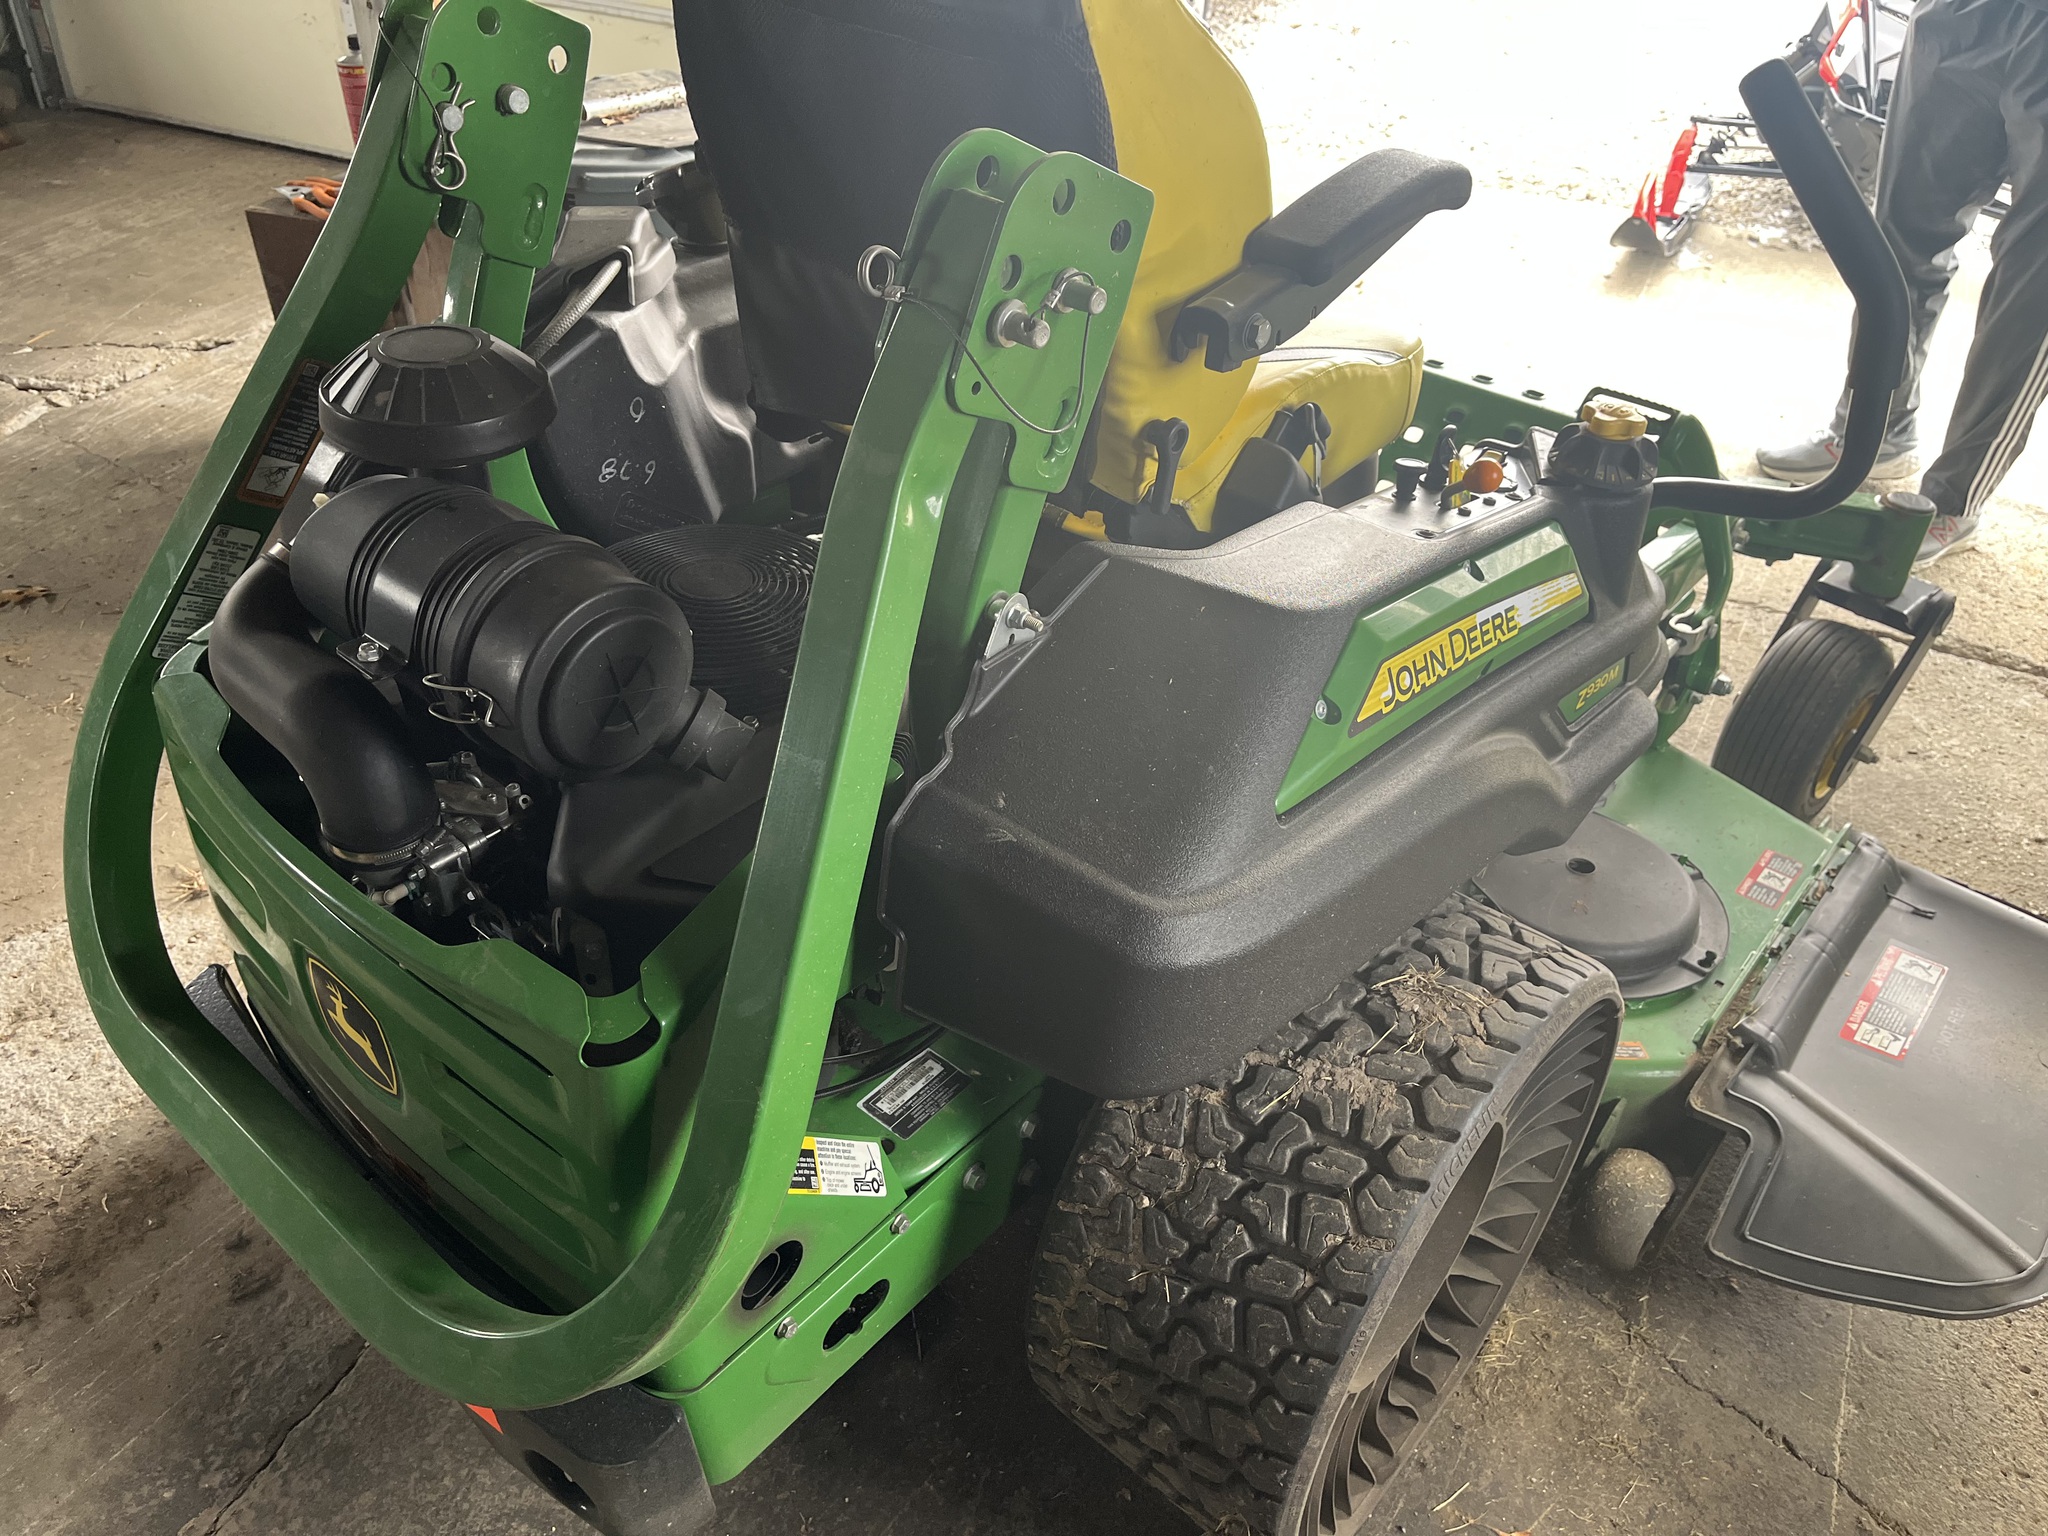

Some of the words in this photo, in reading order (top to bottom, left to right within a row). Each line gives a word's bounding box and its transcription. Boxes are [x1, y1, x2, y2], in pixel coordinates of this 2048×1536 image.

[1384, 644, 1447, 706] JOHN
[1448, 604, 1518, 662] DEERE
[1575, 664, 1619, 710] Z930M
[1849, 999, 1870, 1024] DANGER
[1936, 1026, 1957, 1048] NOT
